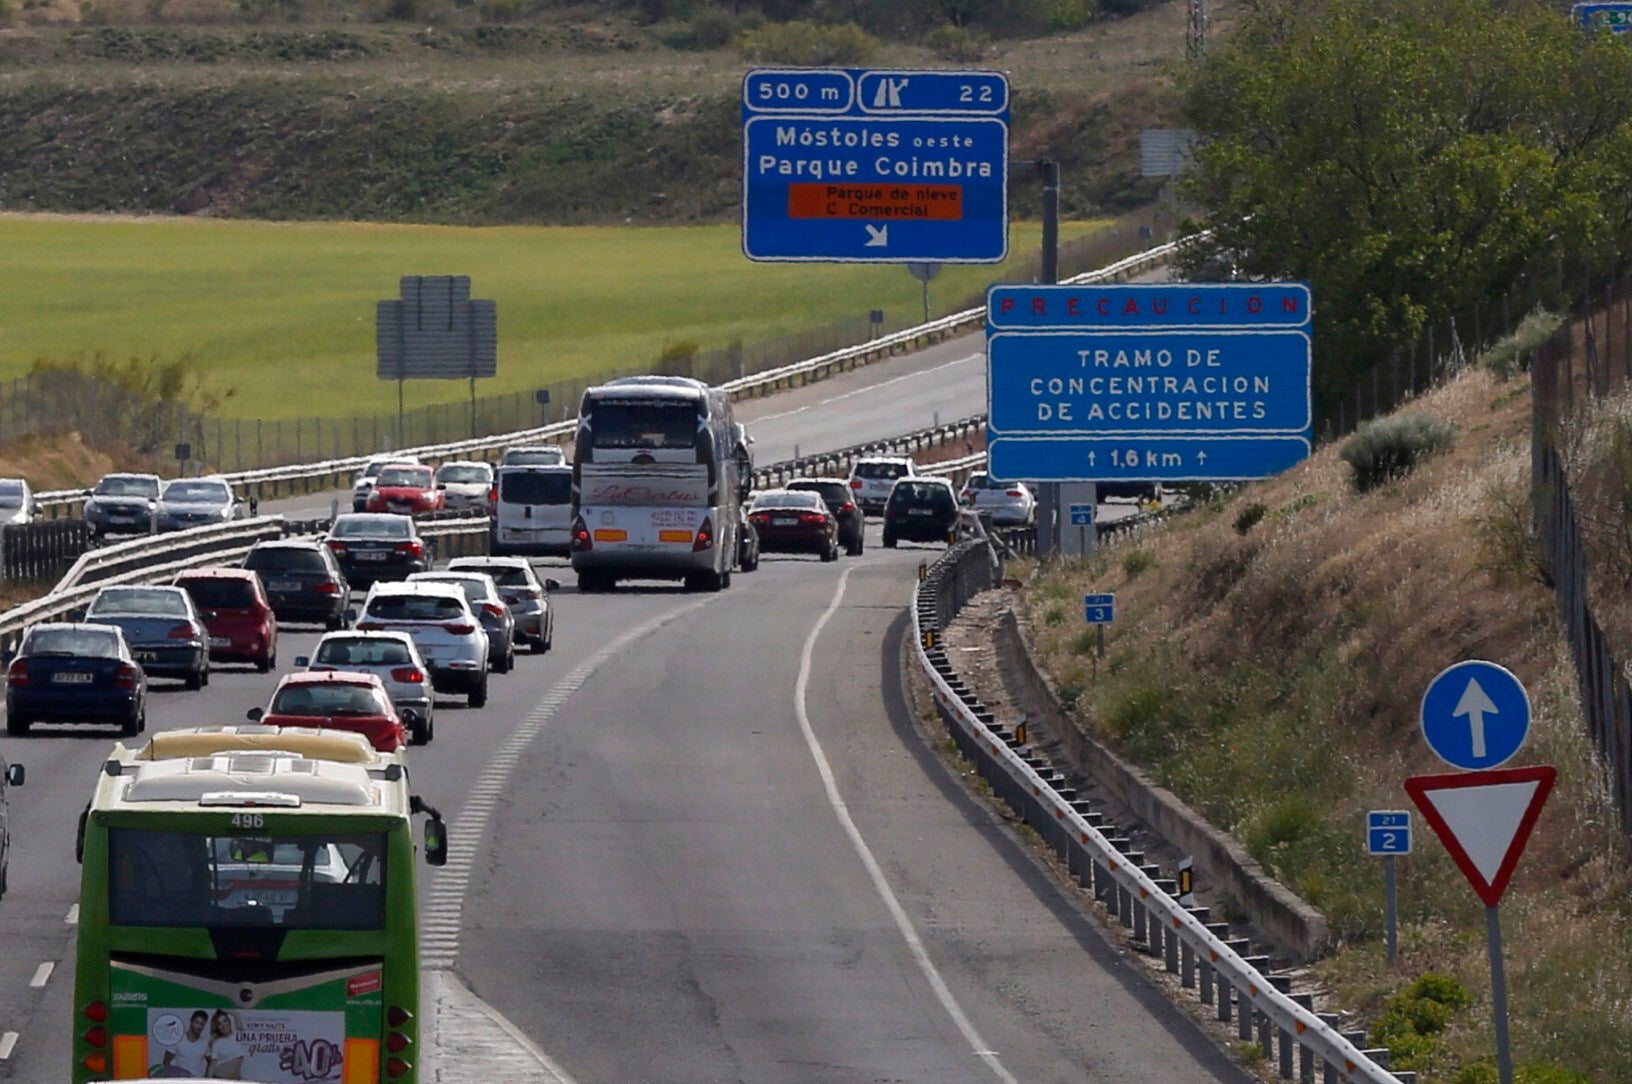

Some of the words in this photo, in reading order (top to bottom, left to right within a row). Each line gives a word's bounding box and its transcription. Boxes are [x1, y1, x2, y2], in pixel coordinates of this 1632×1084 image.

[759, 83, 808, 99] 500
[821, 88, 839, 100] m
[959, 85, 993, 102] 22
[776, 126, 900, 147] Móstoles
[913, 135, 974, 147] oeste
[759, 155, 858, 179] Parque
[875, 156, 992, 177] Coimbra
[826, 187, 882, 204] Parque
[891, 187, 909, 199] de
[917, 187, 957, 200] nieve
[848, 203, 928, 216] Comercial
[1077, 349, 1172, 367] TRAMO
[1187, 350, 1221, 367] DE
[1030, 375, 1270, 396] CONCENTRACION
[1038, 403, 1072, 421] DE
[1087, 401, 1266, 420] ACCIDENTES
[1147, 449, 1182, 467] km
[1094, 607, 1105, 621] 3
[231, 813, 264, 828] 496
[1382, 816, 1396, 825] 21
[1382, 833, 1397, 850] 2
[235, 1032, 257, 1042] UNA
